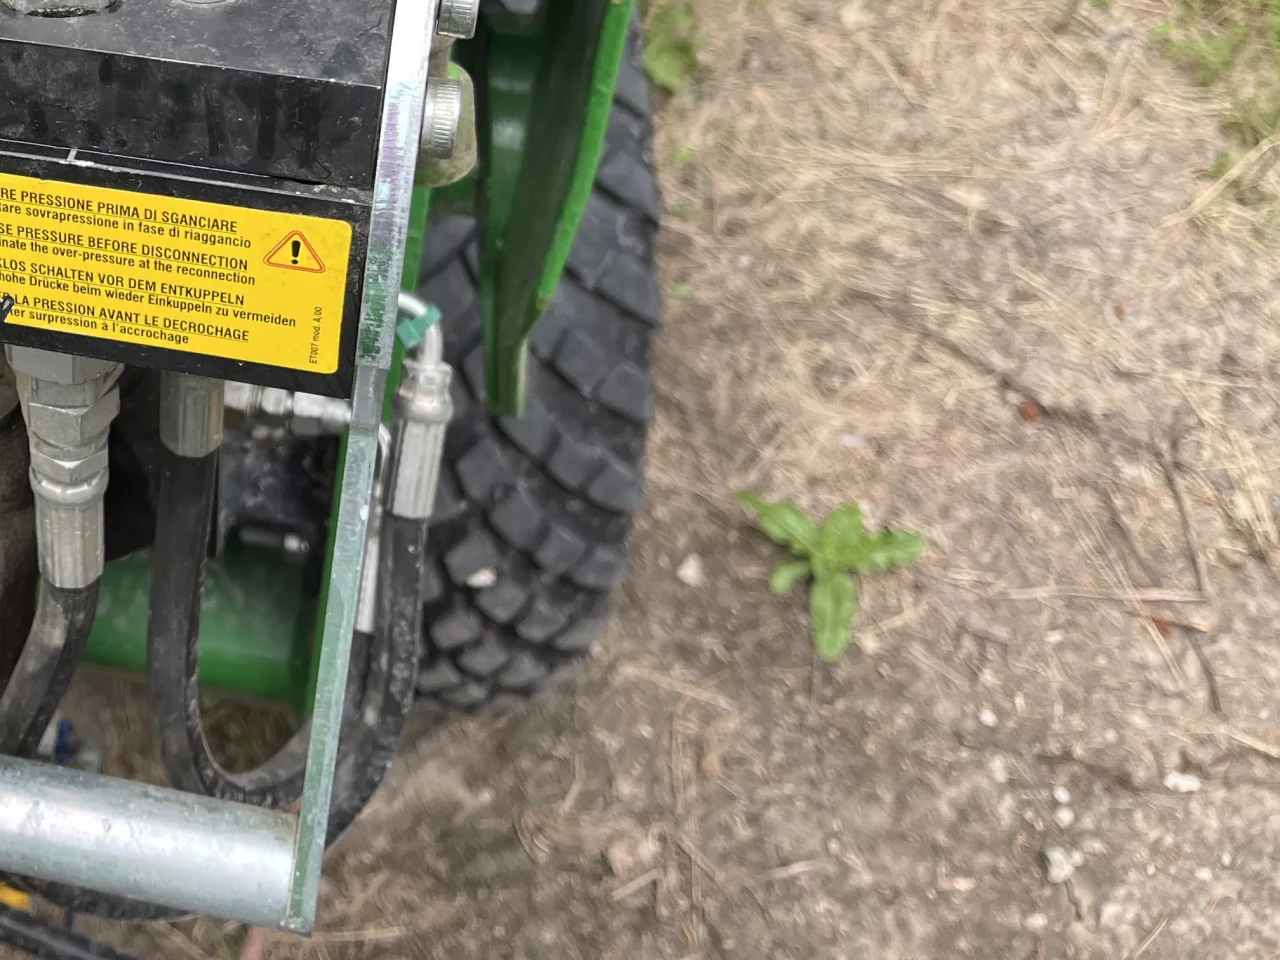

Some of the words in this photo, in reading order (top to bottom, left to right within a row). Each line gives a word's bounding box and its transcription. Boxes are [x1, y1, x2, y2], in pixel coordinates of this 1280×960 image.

[21, 191, 93, 212] PRESSIONE
[97, 202, 140, 218] PRIMA
[144, 208, 157, 221] DI
[161, 211, 237, 233] SGANCIARE
[26, 206, 119, 229] sovrapressione
[123, 220, 134, 231] in
[138, 221, 164, 236] fase
[169, 226, 180, 238] di
[184, 229, 251, 249] riaggancio
[17, 226, 83, 246] PRESSURE
[88, 236, 137, 254] BEFORE
[142, 244, 248, 271] DISCONNECTION
[30, 241, 48, 255] the
[52, 246, 135, 267] over-pressure
[138, 257, 150, 270] at
[154, 259, 172, 273] the
[176, 264, 256, 286] reconnection
[29, 276, 69, 292] Drücke
[73, 283, 101, 297] beim
[105, 288, 145, 304] wieder
[148, 292, 212, 315] Einkuppeln
[215, 306, 229, 317] zu
[233, 308, 296, 328] vermeiden
[31, 263, 94, 282] SCHALTEN
[98, 273, 124, 287] VOR
[128, 278, 156, 292] DEM
[161, 283, 244, 306] ENTKUPPELN
[15, 295, 30, 307] LA
[33, 297, 95, 317] PRESSION
[99, 307, 141, 325] AVANT
[144, 315, 159, 327] LE
[163, 317, 249, 341] DECROCHAGE
[29, 310, 97, 330] surpression
[102, 320, 108, 331] à
[112, 322, 189, 344] l'accrochage
